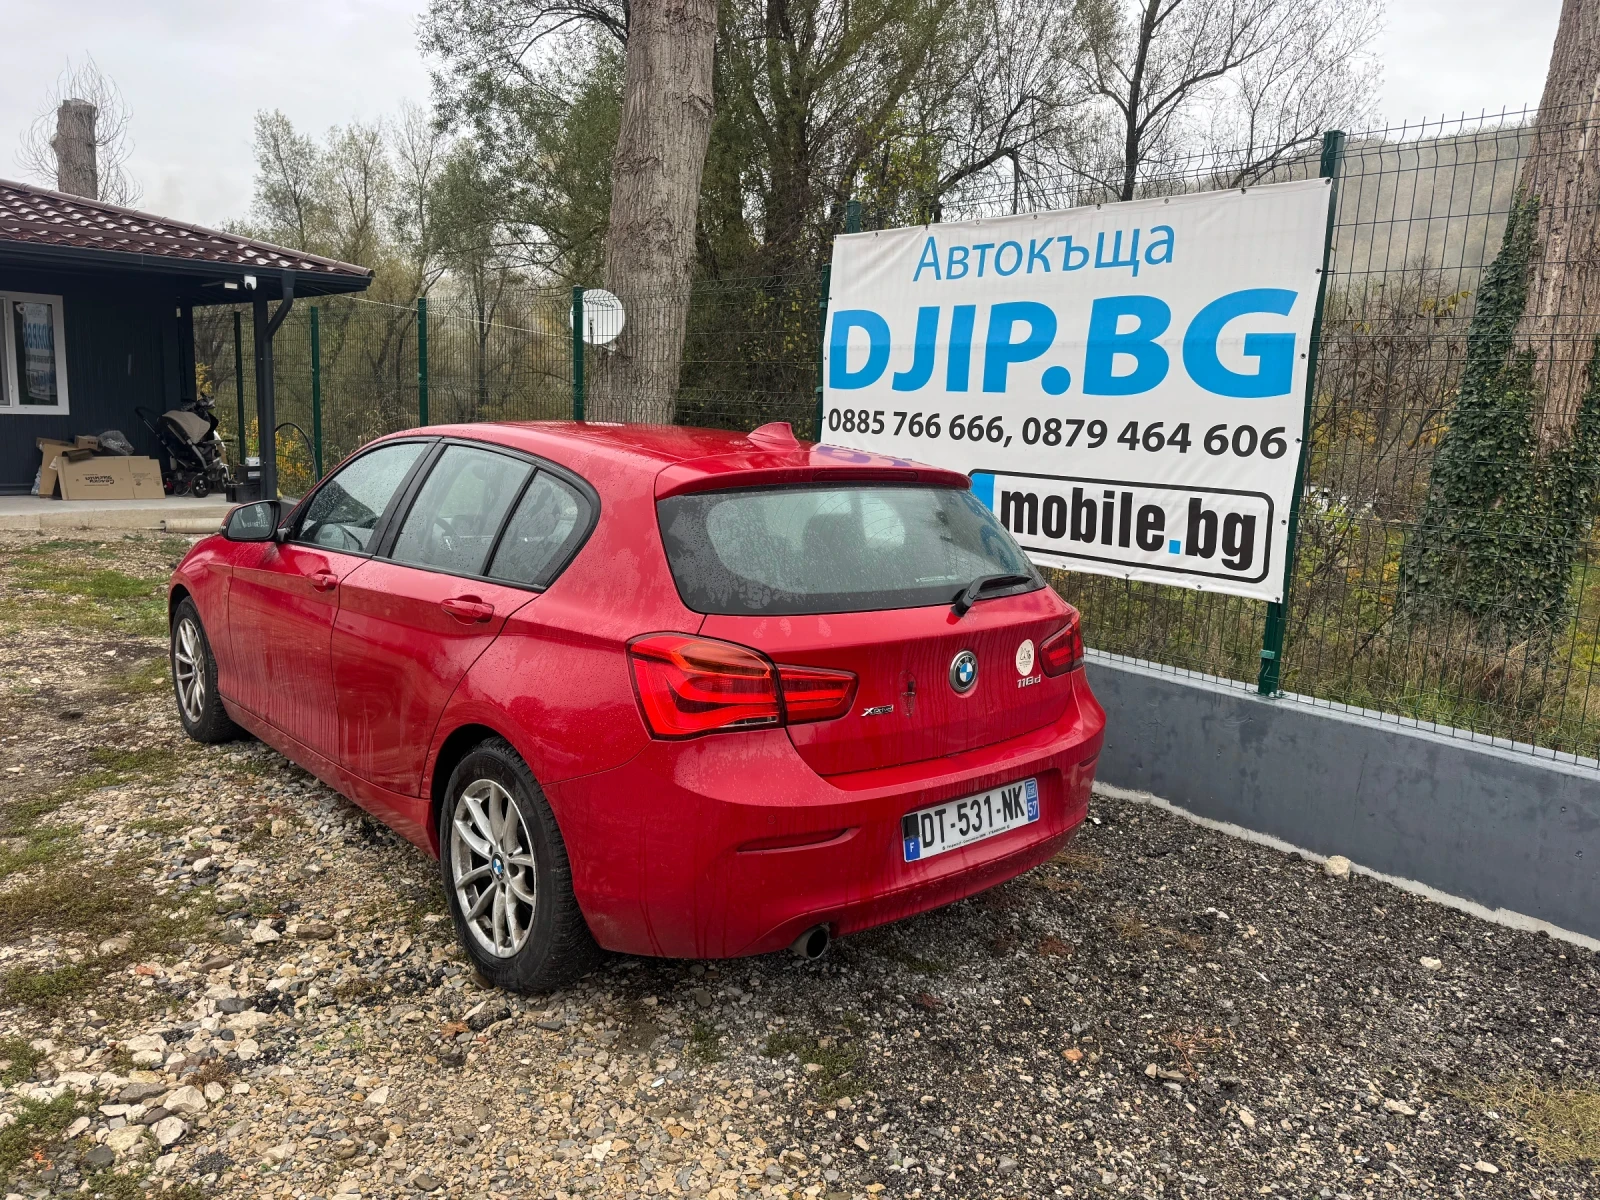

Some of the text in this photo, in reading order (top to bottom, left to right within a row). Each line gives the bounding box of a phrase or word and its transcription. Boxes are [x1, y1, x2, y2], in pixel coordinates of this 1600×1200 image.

[912, 224, 1176, 283] Автокъща
[828, 287, 1299, 399] DJIP.BG
[828, 408, 1288, 459] 0885 766 666, 0879 464 606
[1000, 486, 1257, 571] mobile.bg
[1017, 674, 1041, 688] 118d
[920, 785, 1025, 849] DT-531-NK
[1028, 800, 1037, 817] 57
[909, 842, 915, 853] F
